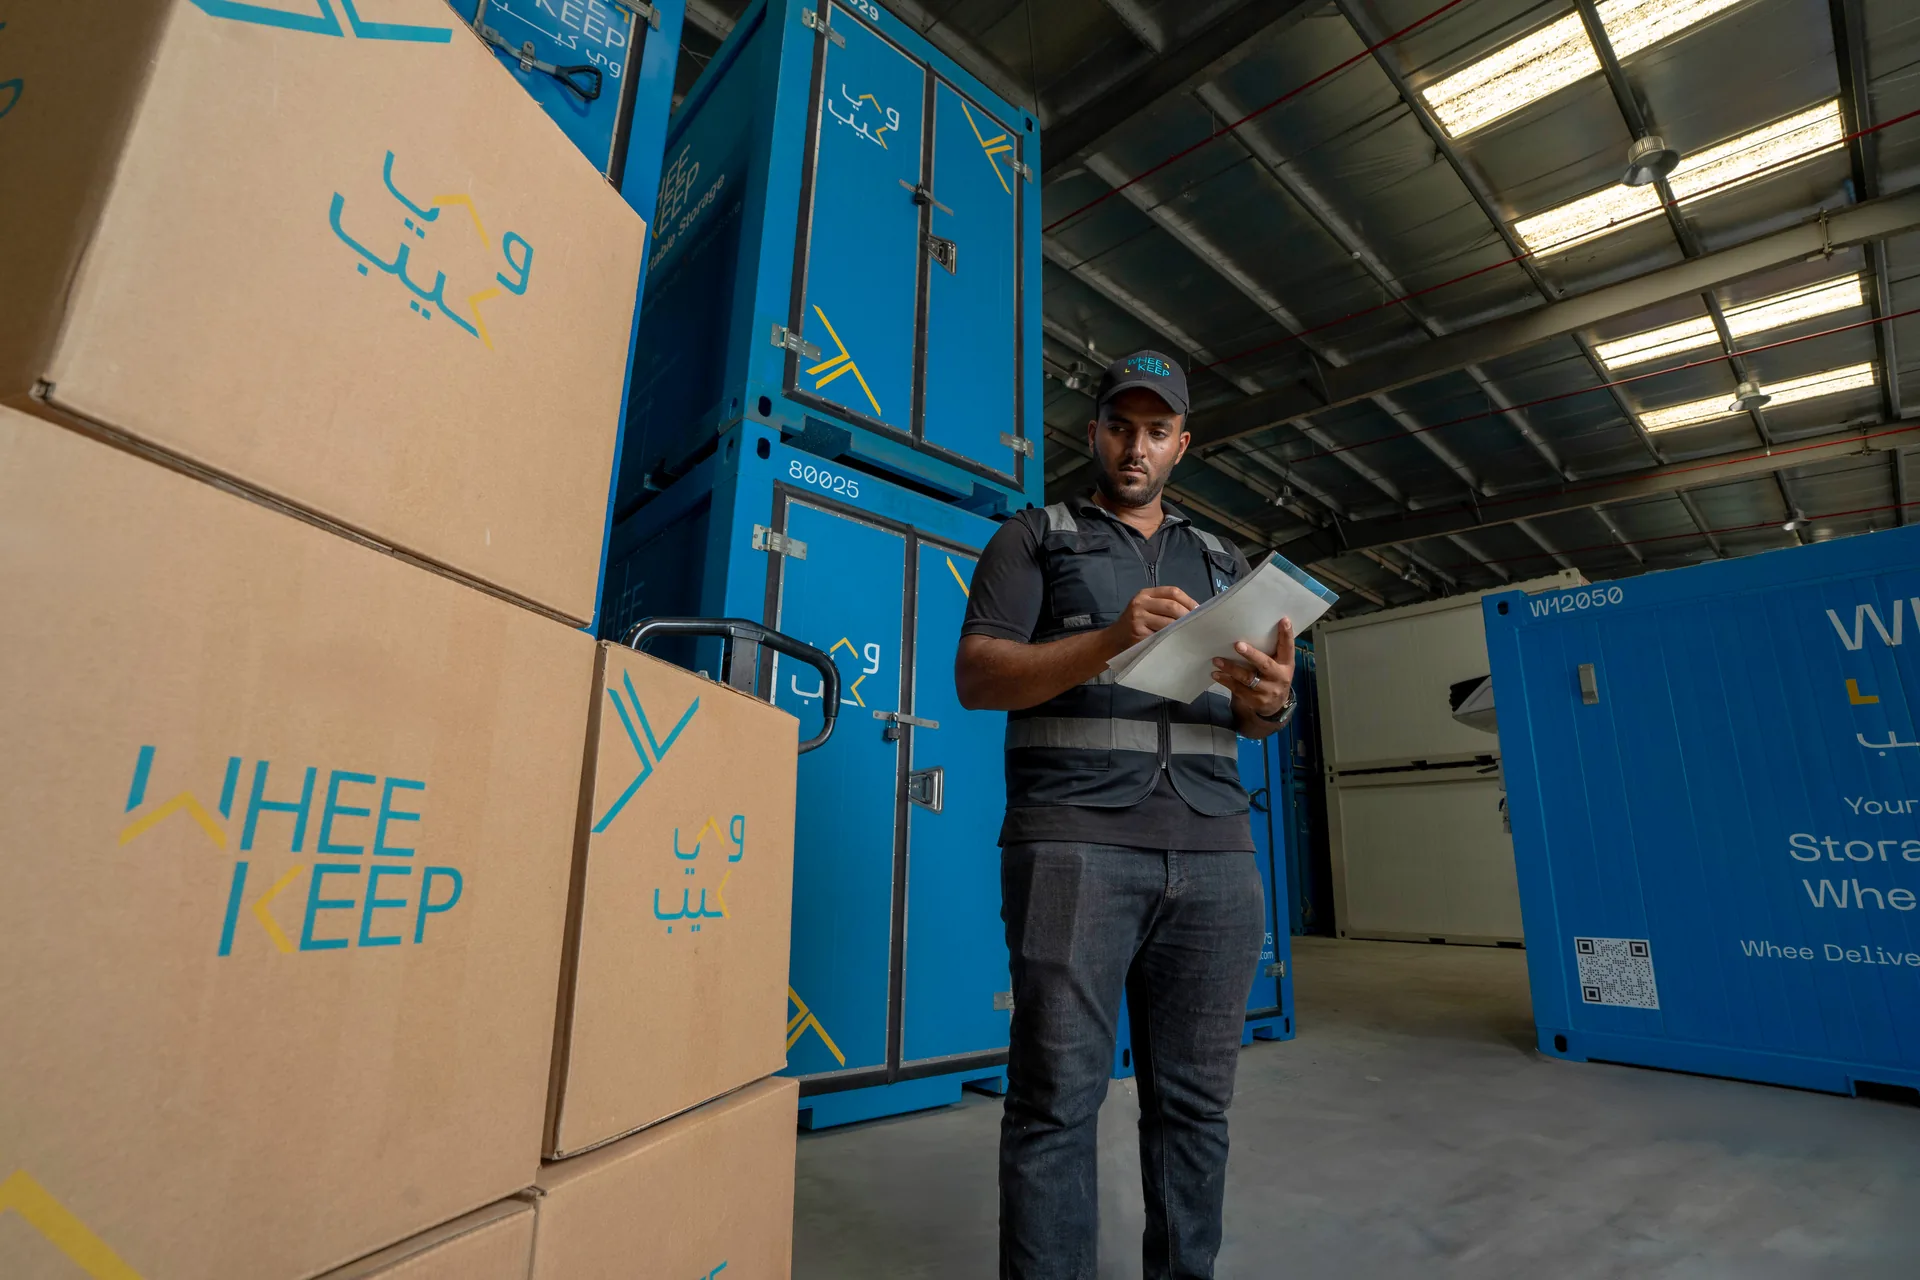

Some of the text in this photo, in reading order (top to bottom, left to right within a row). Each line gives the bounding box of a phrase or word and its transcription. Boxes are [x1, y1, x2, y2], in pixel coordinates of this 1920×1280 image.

[677, 173, 725, 237] Storage
[1127, 356, 1163, 366] WHEE
[1137, 363, 1170, 377] KEEP
[789, 460, 859, 499] 80025
[1529, 586, 1623, 618] W12050
[118, 745, 426, 858] WHEE
[1844, 796, 1919, 816] Your
[218, 861, 464, 957] KEEP
[1803, 878, 1918, 911] Whe
[1740, 940, 1920, 967] Whee Delive
